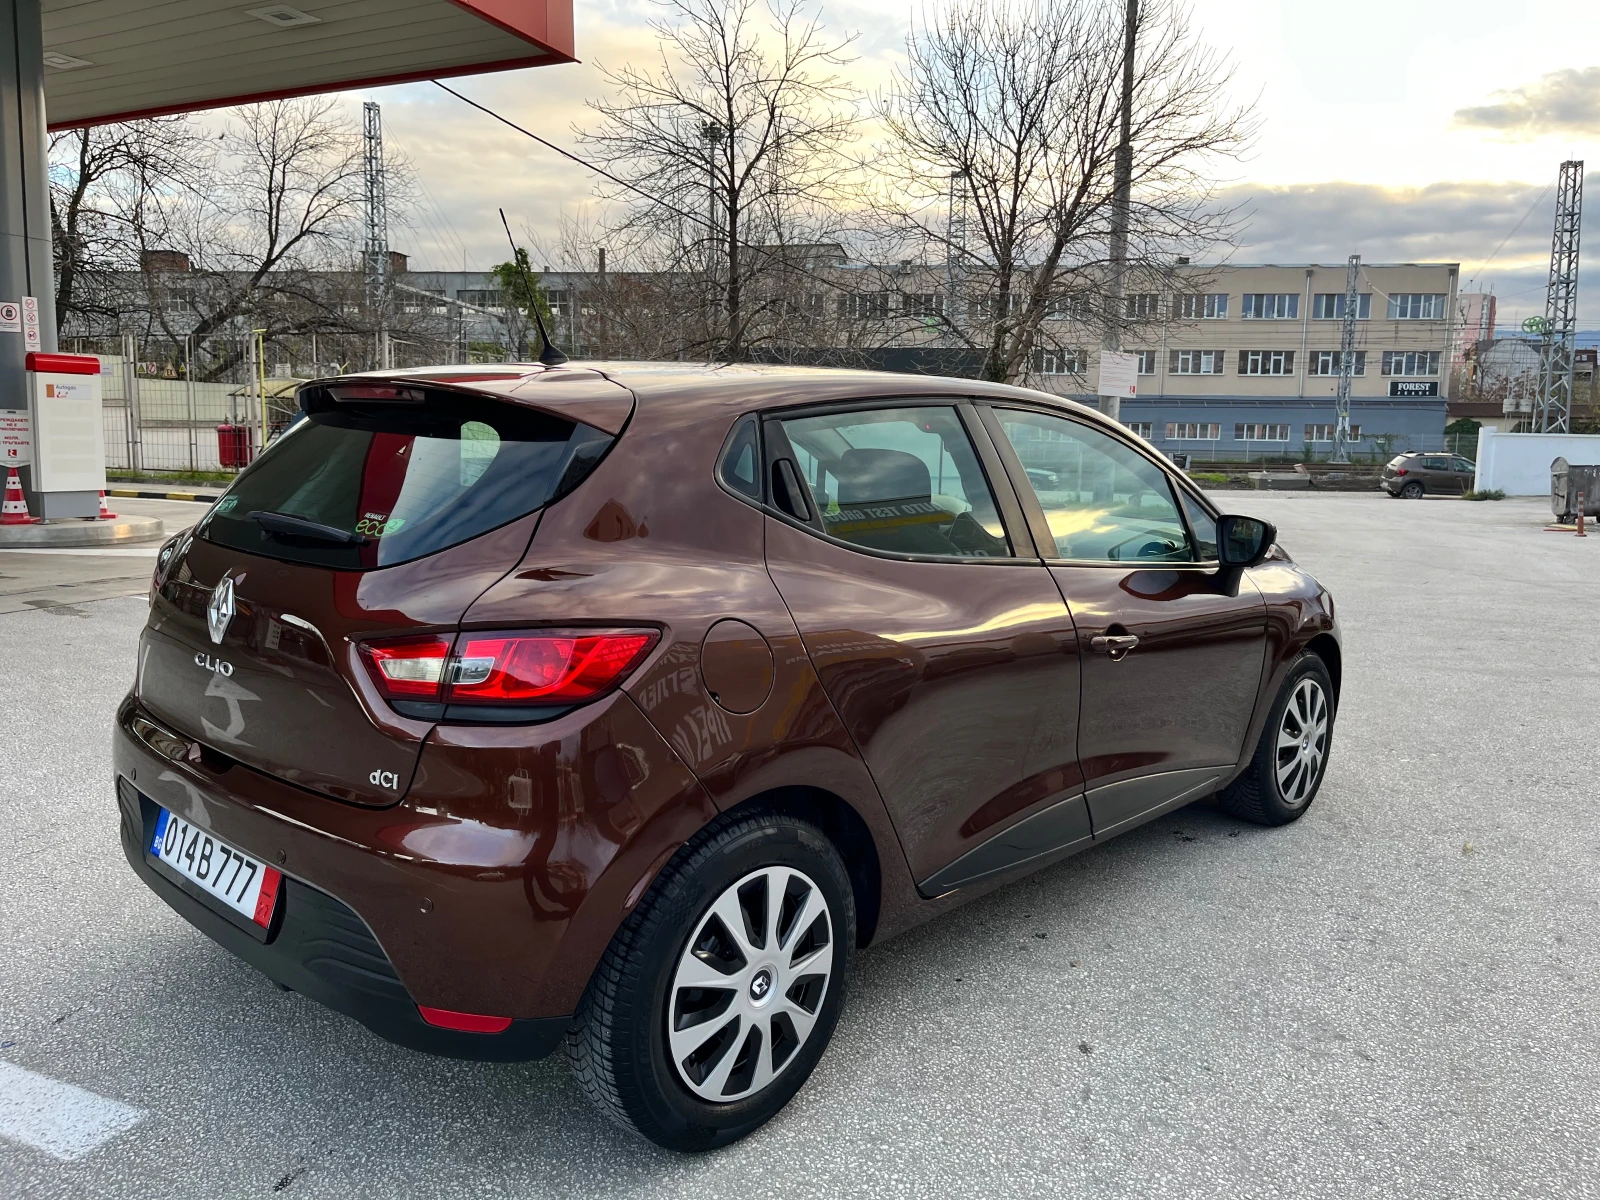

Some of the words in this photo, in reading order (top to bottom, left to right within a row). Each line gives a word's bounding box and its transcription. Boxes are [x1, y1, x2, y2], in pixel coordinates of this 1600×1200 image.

[1398, 382, 1430, 390] FOREST
[194, 651, 234, 677] CLIO
[153, 834, 163, 850] BG
